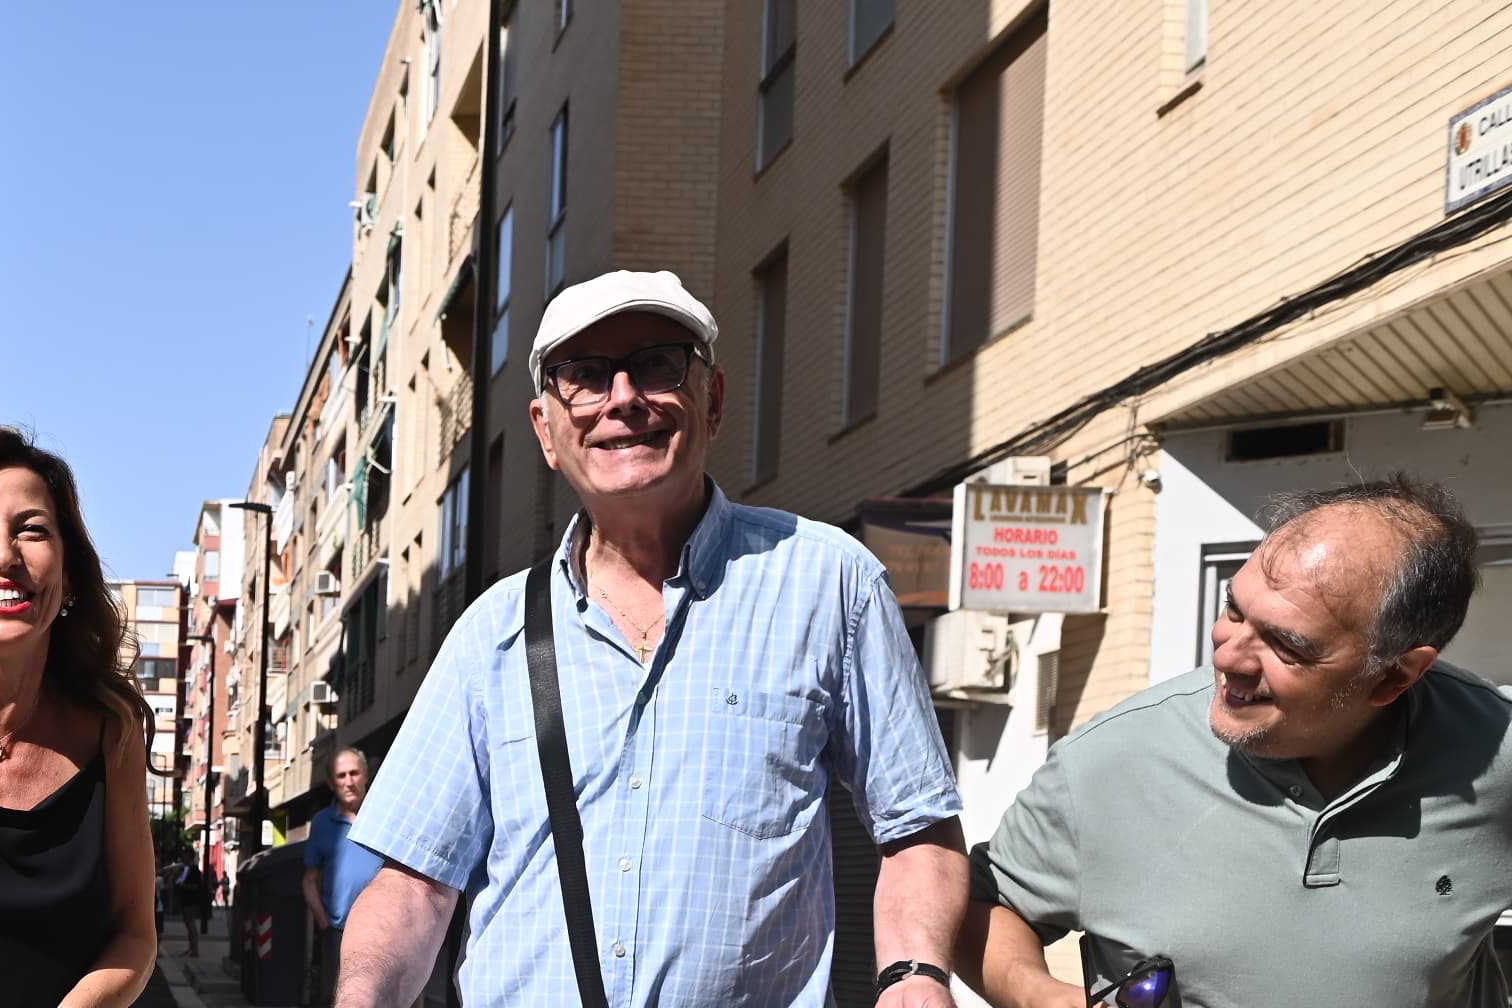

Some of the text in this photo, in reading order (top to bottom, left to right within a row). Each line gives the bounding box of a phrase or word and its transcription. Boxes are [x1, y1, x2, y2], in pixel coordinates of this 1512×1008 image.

[1460, 143, 1512, 190] UTRILLA
[974, 489, 1087, 525] LAVAMAX
[994, 528, 1059, 545] HORARIO
[976, 546, 1016, 557] TODOS
[1020, 550, 1043, 559] LOS
[969, 562, 1085, 593] 8:00 a 22:00
